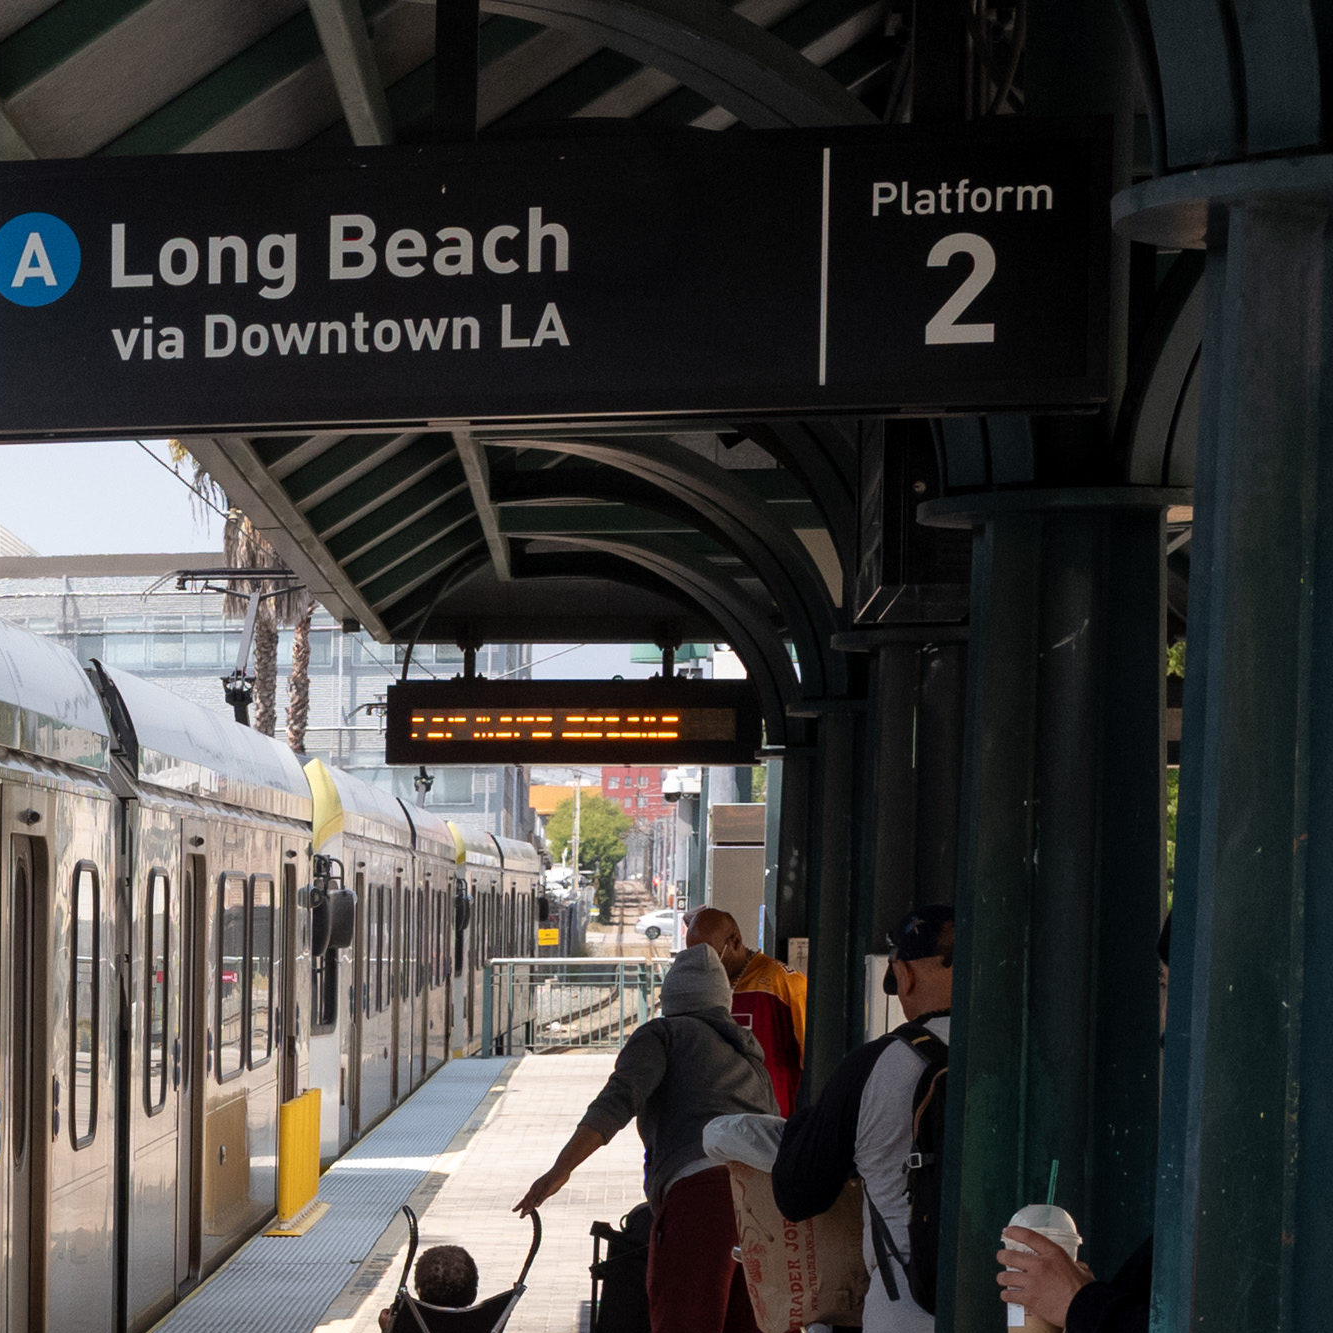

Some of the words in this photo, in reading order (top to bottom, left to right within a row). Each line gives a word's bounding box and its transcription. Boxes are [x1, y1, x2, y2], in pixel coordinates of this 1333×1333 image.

[872, 178, 1053, 217] Platform
[11, 232, 58, 288] A
[111, 221, 298, 300] Long
[329, 206, 571, 281] Beach
[925, 232, 997, 345] 2
[111, 317, 185, 361] via
[204, 311, 481, 359] Downtown
[501, 302, 571, 348] LA
[787, 1259, 804, 1329] TRADER
